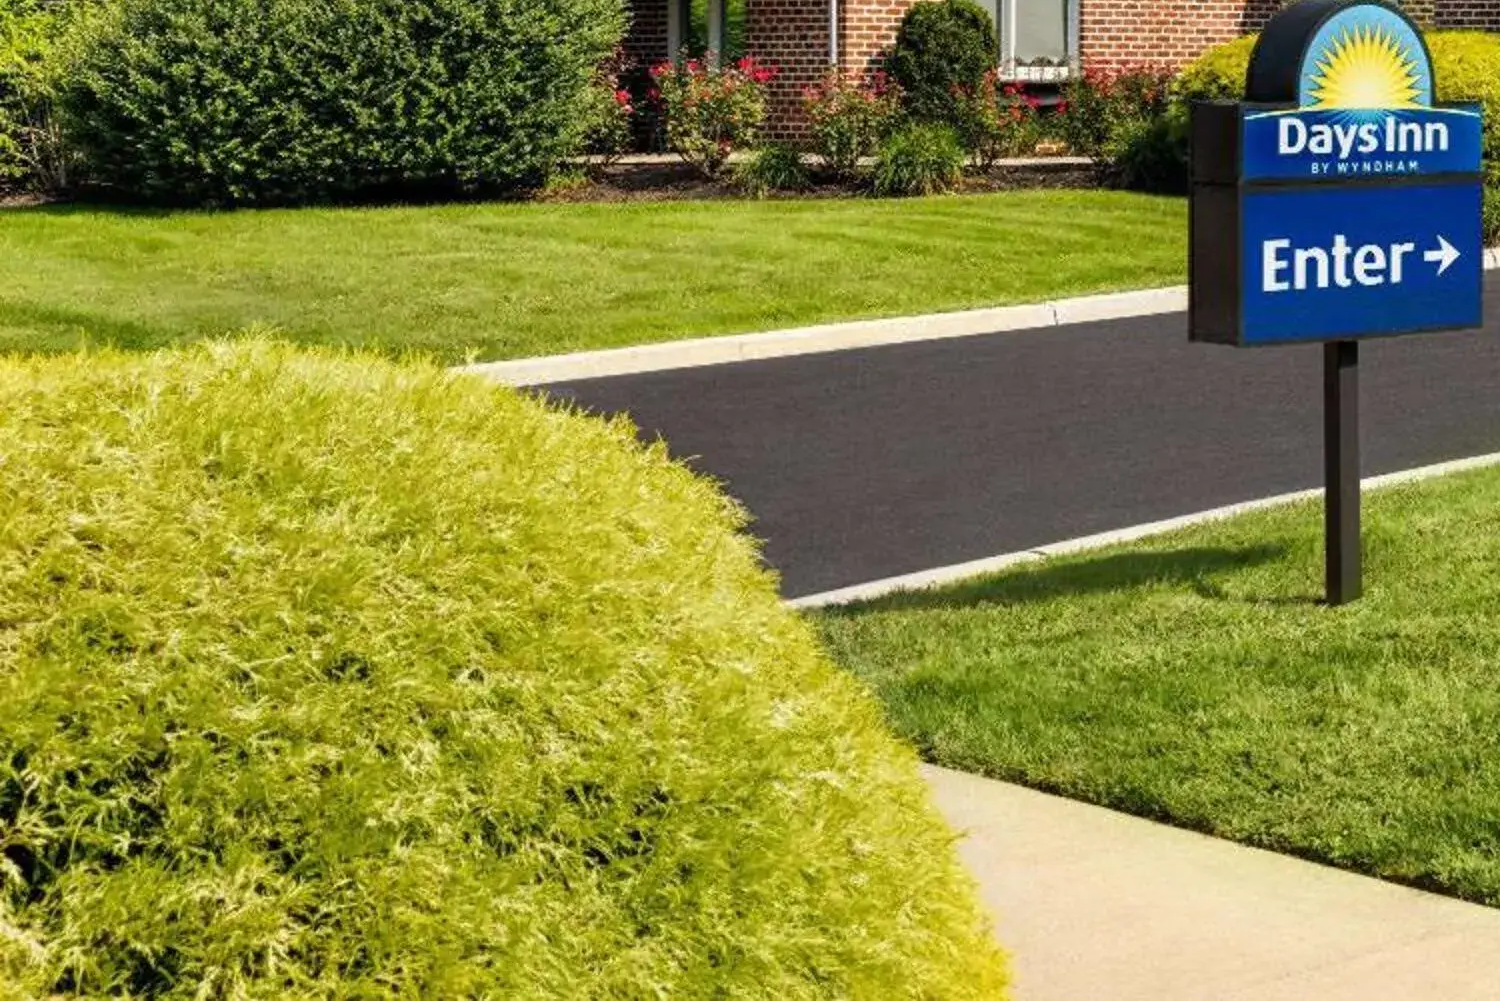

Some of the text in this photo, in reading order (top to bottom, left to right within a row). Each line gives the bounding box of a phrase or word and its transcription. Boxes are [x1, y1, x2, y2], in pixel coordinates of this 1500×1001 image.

[1278, 116, 1449, 159] Days Inn
[1311, 160, 1419, 175] BY WYNDHAM
[1262, 234, 1415, 293] Enter
